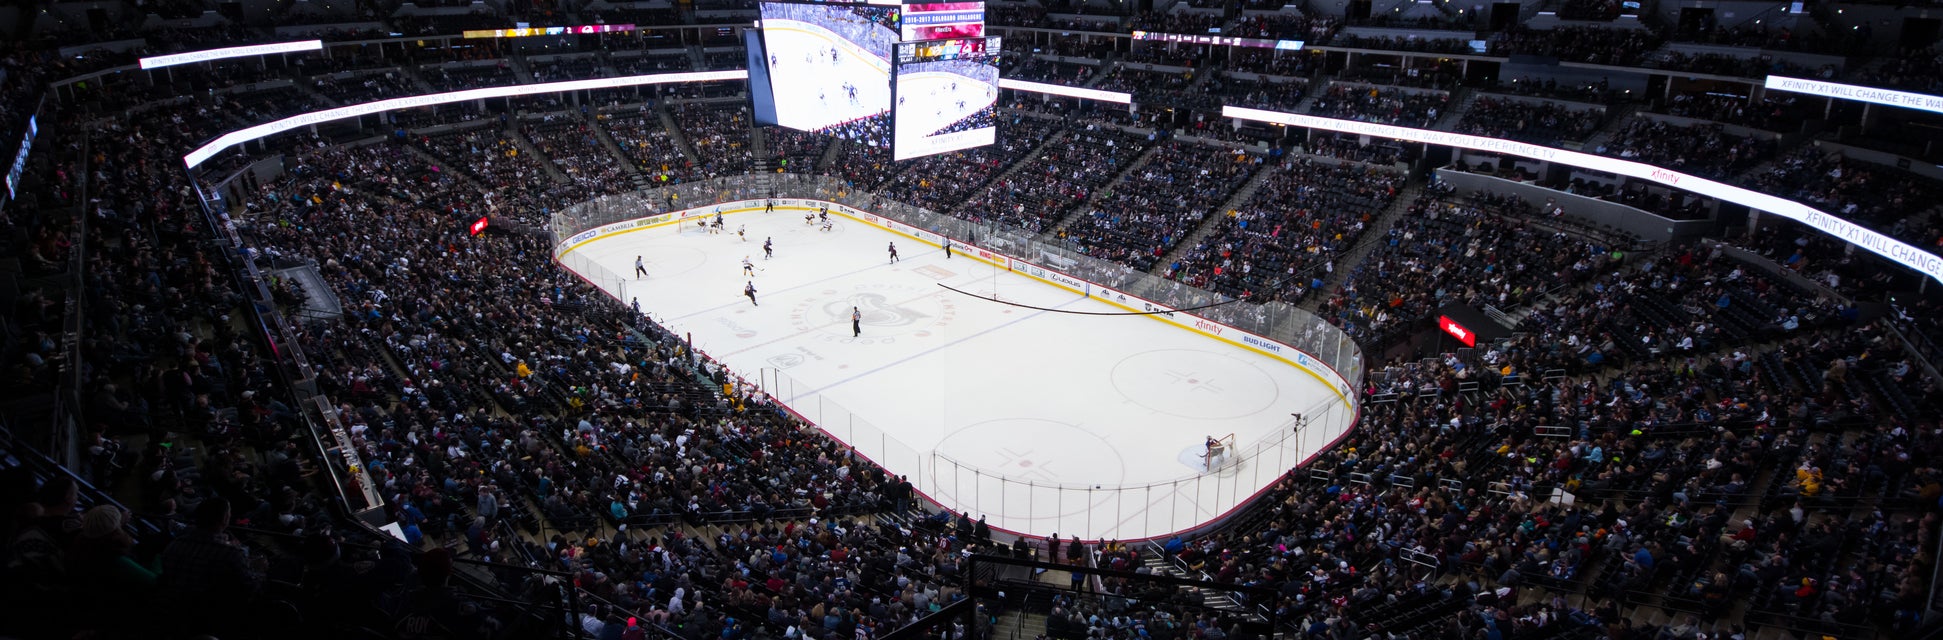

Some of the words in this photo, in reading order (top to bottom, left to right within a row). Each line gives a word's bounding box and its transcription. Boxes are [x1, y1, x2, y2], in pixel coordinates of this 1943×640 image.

[1781, 79, 1816, 92] XFINITY
[1818, 83, 1829, 93] X1
[1831, 86, 1854, 97] WILL
[1855, 89, 1899, 103] CHANGE
[1901, 95, 1923, 106] THE
[300, 114, 318, 124] WILL
[319, 109, 350, 121] CHANGE
[351, 106, 365, 114] THE
[382, 99, 397, 108] YOU
[399, 94, 447, 107] EXPERIENCE
[1287, 115, 1320, 126] XFINITY
[1334, 121, 1354, 131] WILL
[1357, 123, 1397, 136] CHANGE
[1401, 128, 1419, 139] THE
[1422, 132, 1445, 142] WAY
[1448, 135, 1470, 146] YOU
[1472, 138, 1538, 157] EXPERIENCE
[1541, 149, 1556, 159] TV
[1651, 169, 1680, 185] xfinity
[573, 230, 597, 244] GEICO
[1805, 209, 1847, 235] XFINITY
[1846, 225, 1860, 241] X1
[1862, 231, 1888, 253] WILL
[1891, 243, 1942, 275] CHANGE
[1058, 277, 1081, 288] LEXUS
[1195, 319, 1223, 336] xfinity
[1243, 336, 1258, 346] BUD
[1259, 341, 1281, 353] LIGHT
[407, 616, 430, 634] ROY
